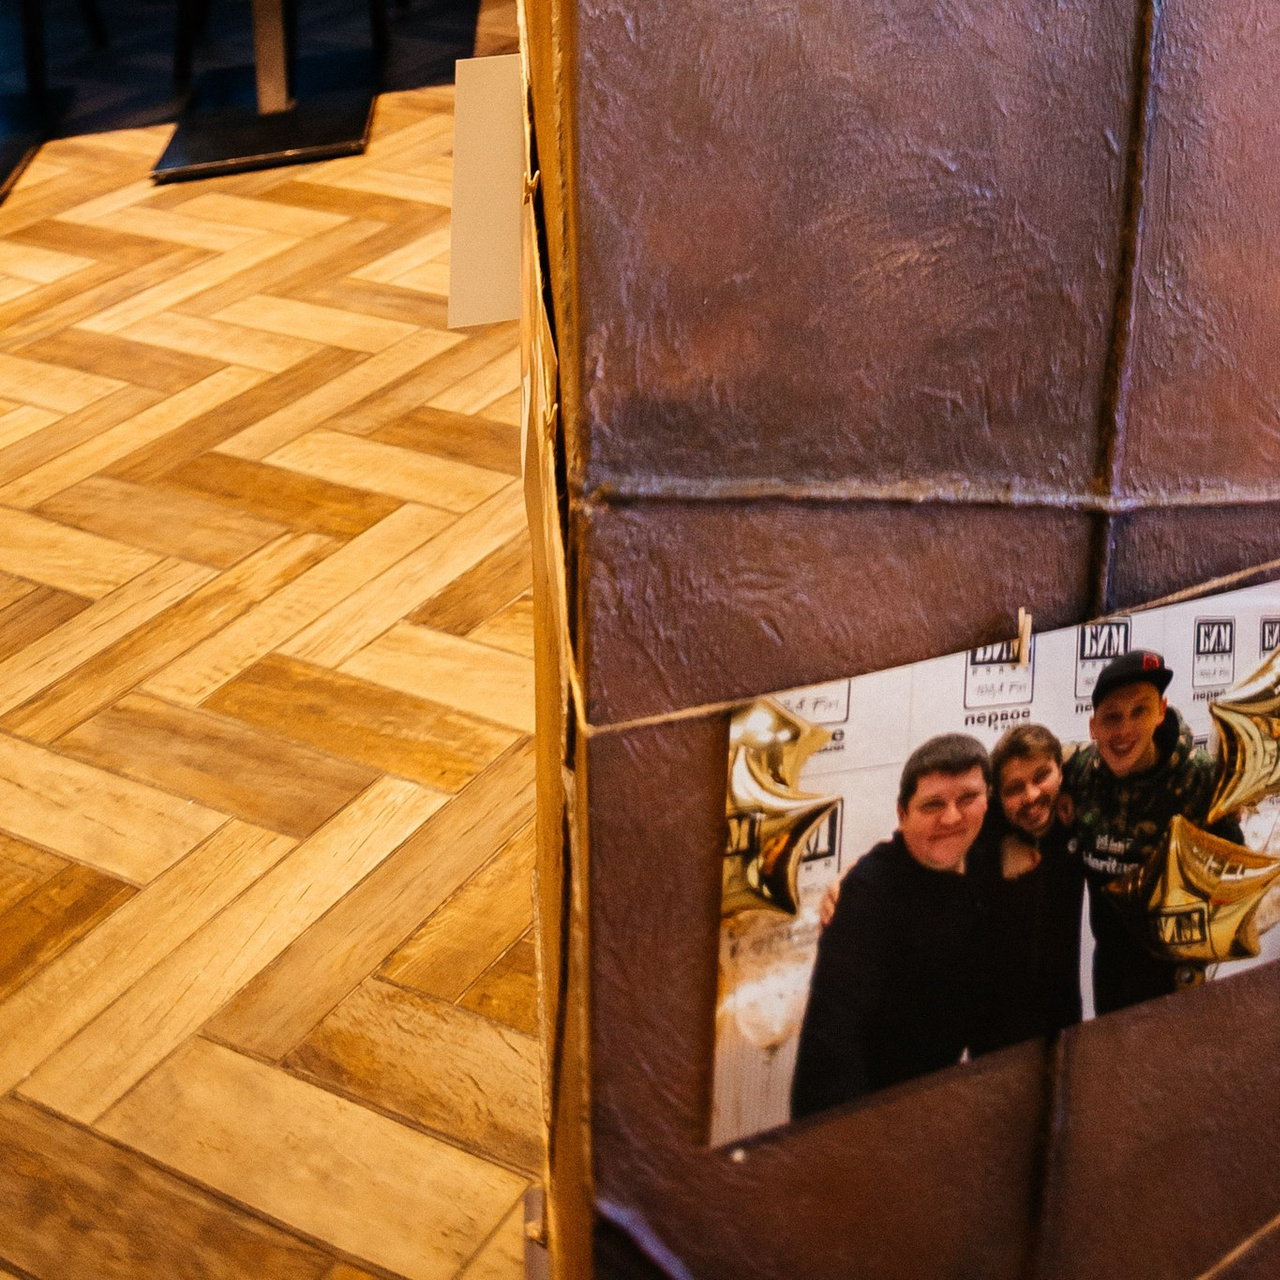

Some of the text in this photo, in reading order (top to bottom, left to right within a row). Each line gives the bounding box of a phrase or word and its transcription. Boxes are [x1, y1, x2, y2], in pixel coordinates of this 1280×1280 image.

[1084, 624, 1125, 657] БИМ
[1199, 623, 1231, 652] БИМ
[964, 708, 1031, 727] первое
